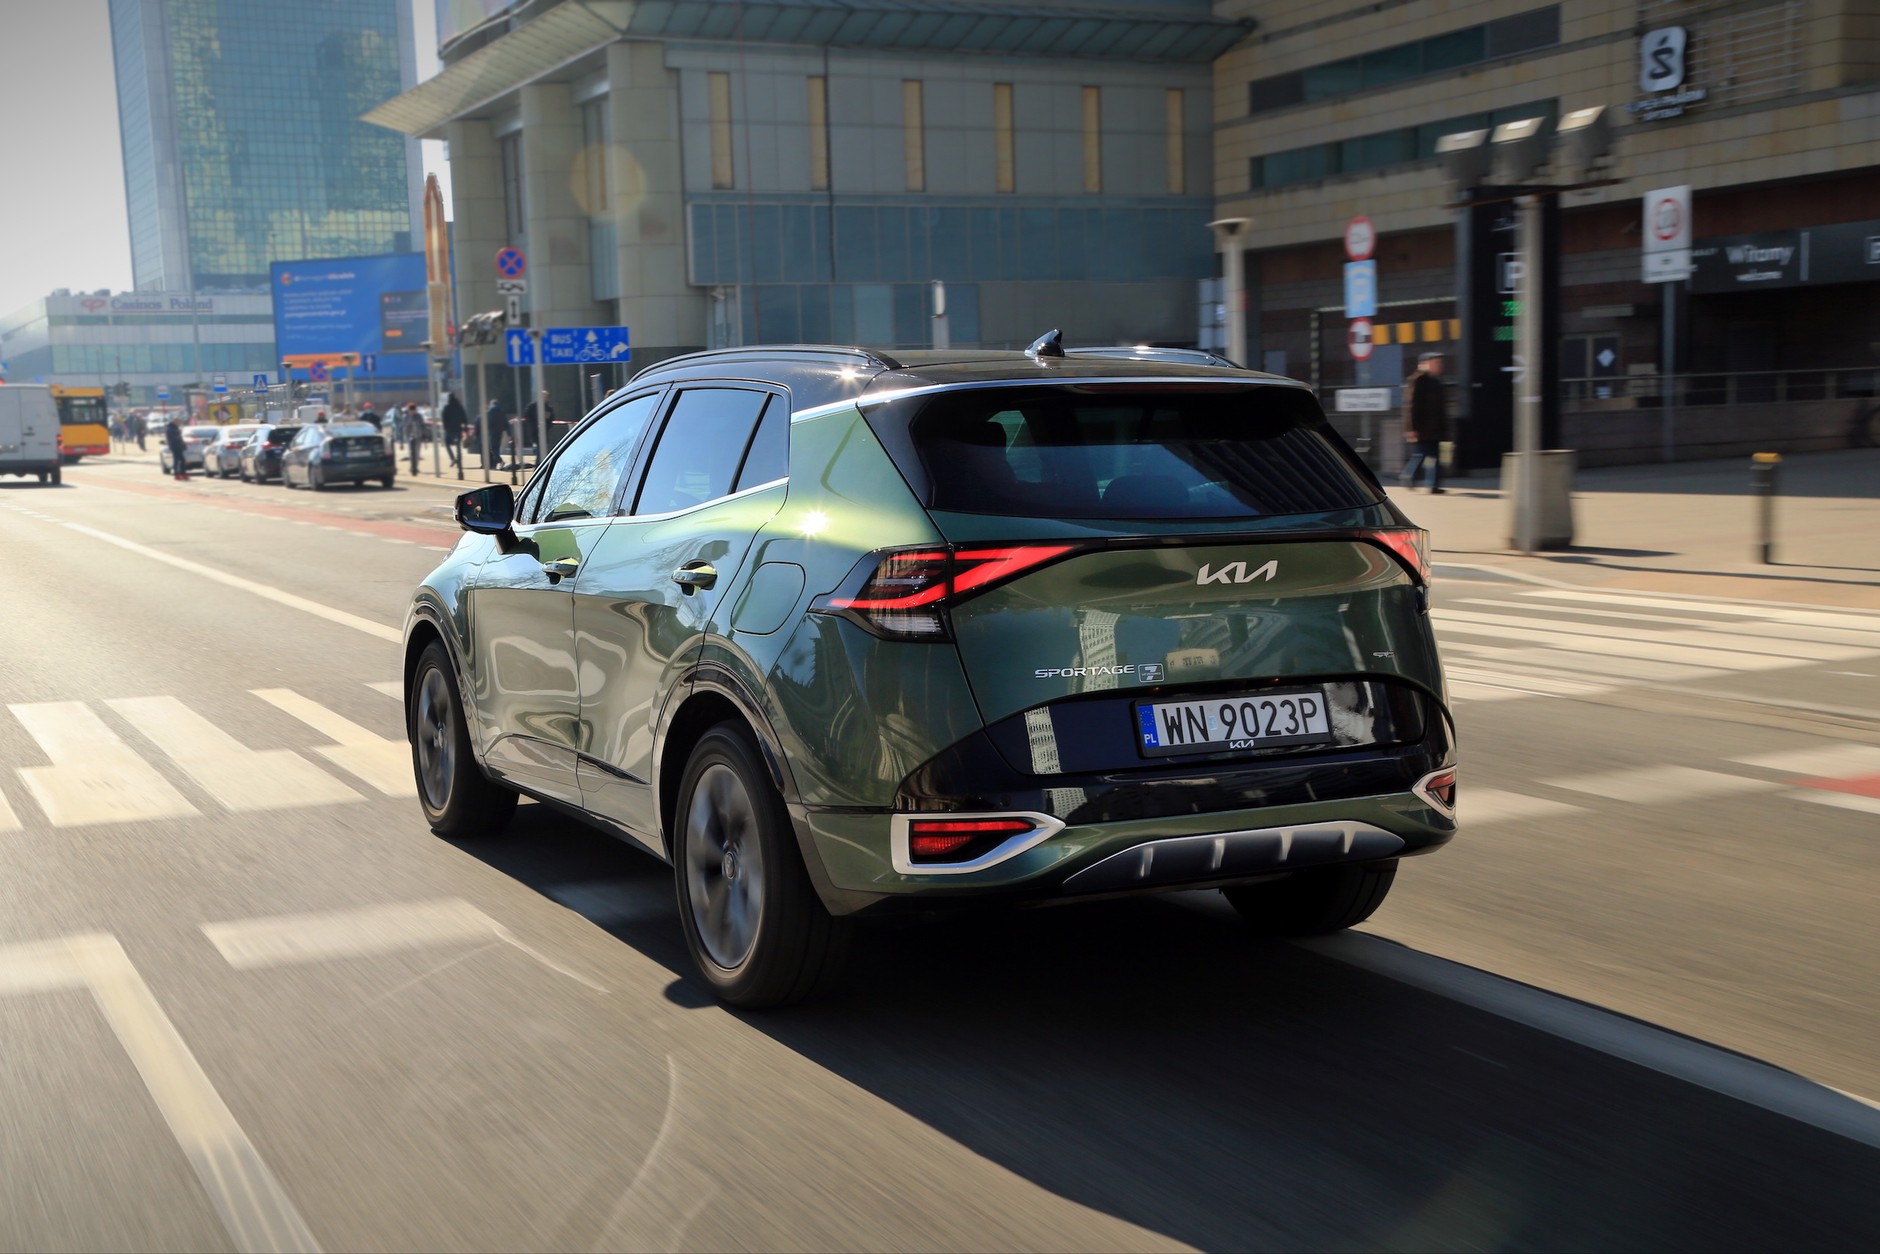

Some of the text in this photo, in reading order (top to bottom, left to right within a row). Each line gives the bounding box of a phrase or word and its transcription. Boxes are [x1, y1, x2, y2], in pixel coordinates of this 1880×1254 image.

[111, 299, 162, 310] Casinos
[551, 334, 572, 344] BUS
[551, 348, 574, 358] TAXI
[1196, 560, 1279, 585] KIA
[1035, 664, 1135, 678] SPORTAGE
[1161, 697, 1318, 745] WN 9023P
[1144, 733, 1157, 745] PL
[1229, 739, 1255, 750] KIA
